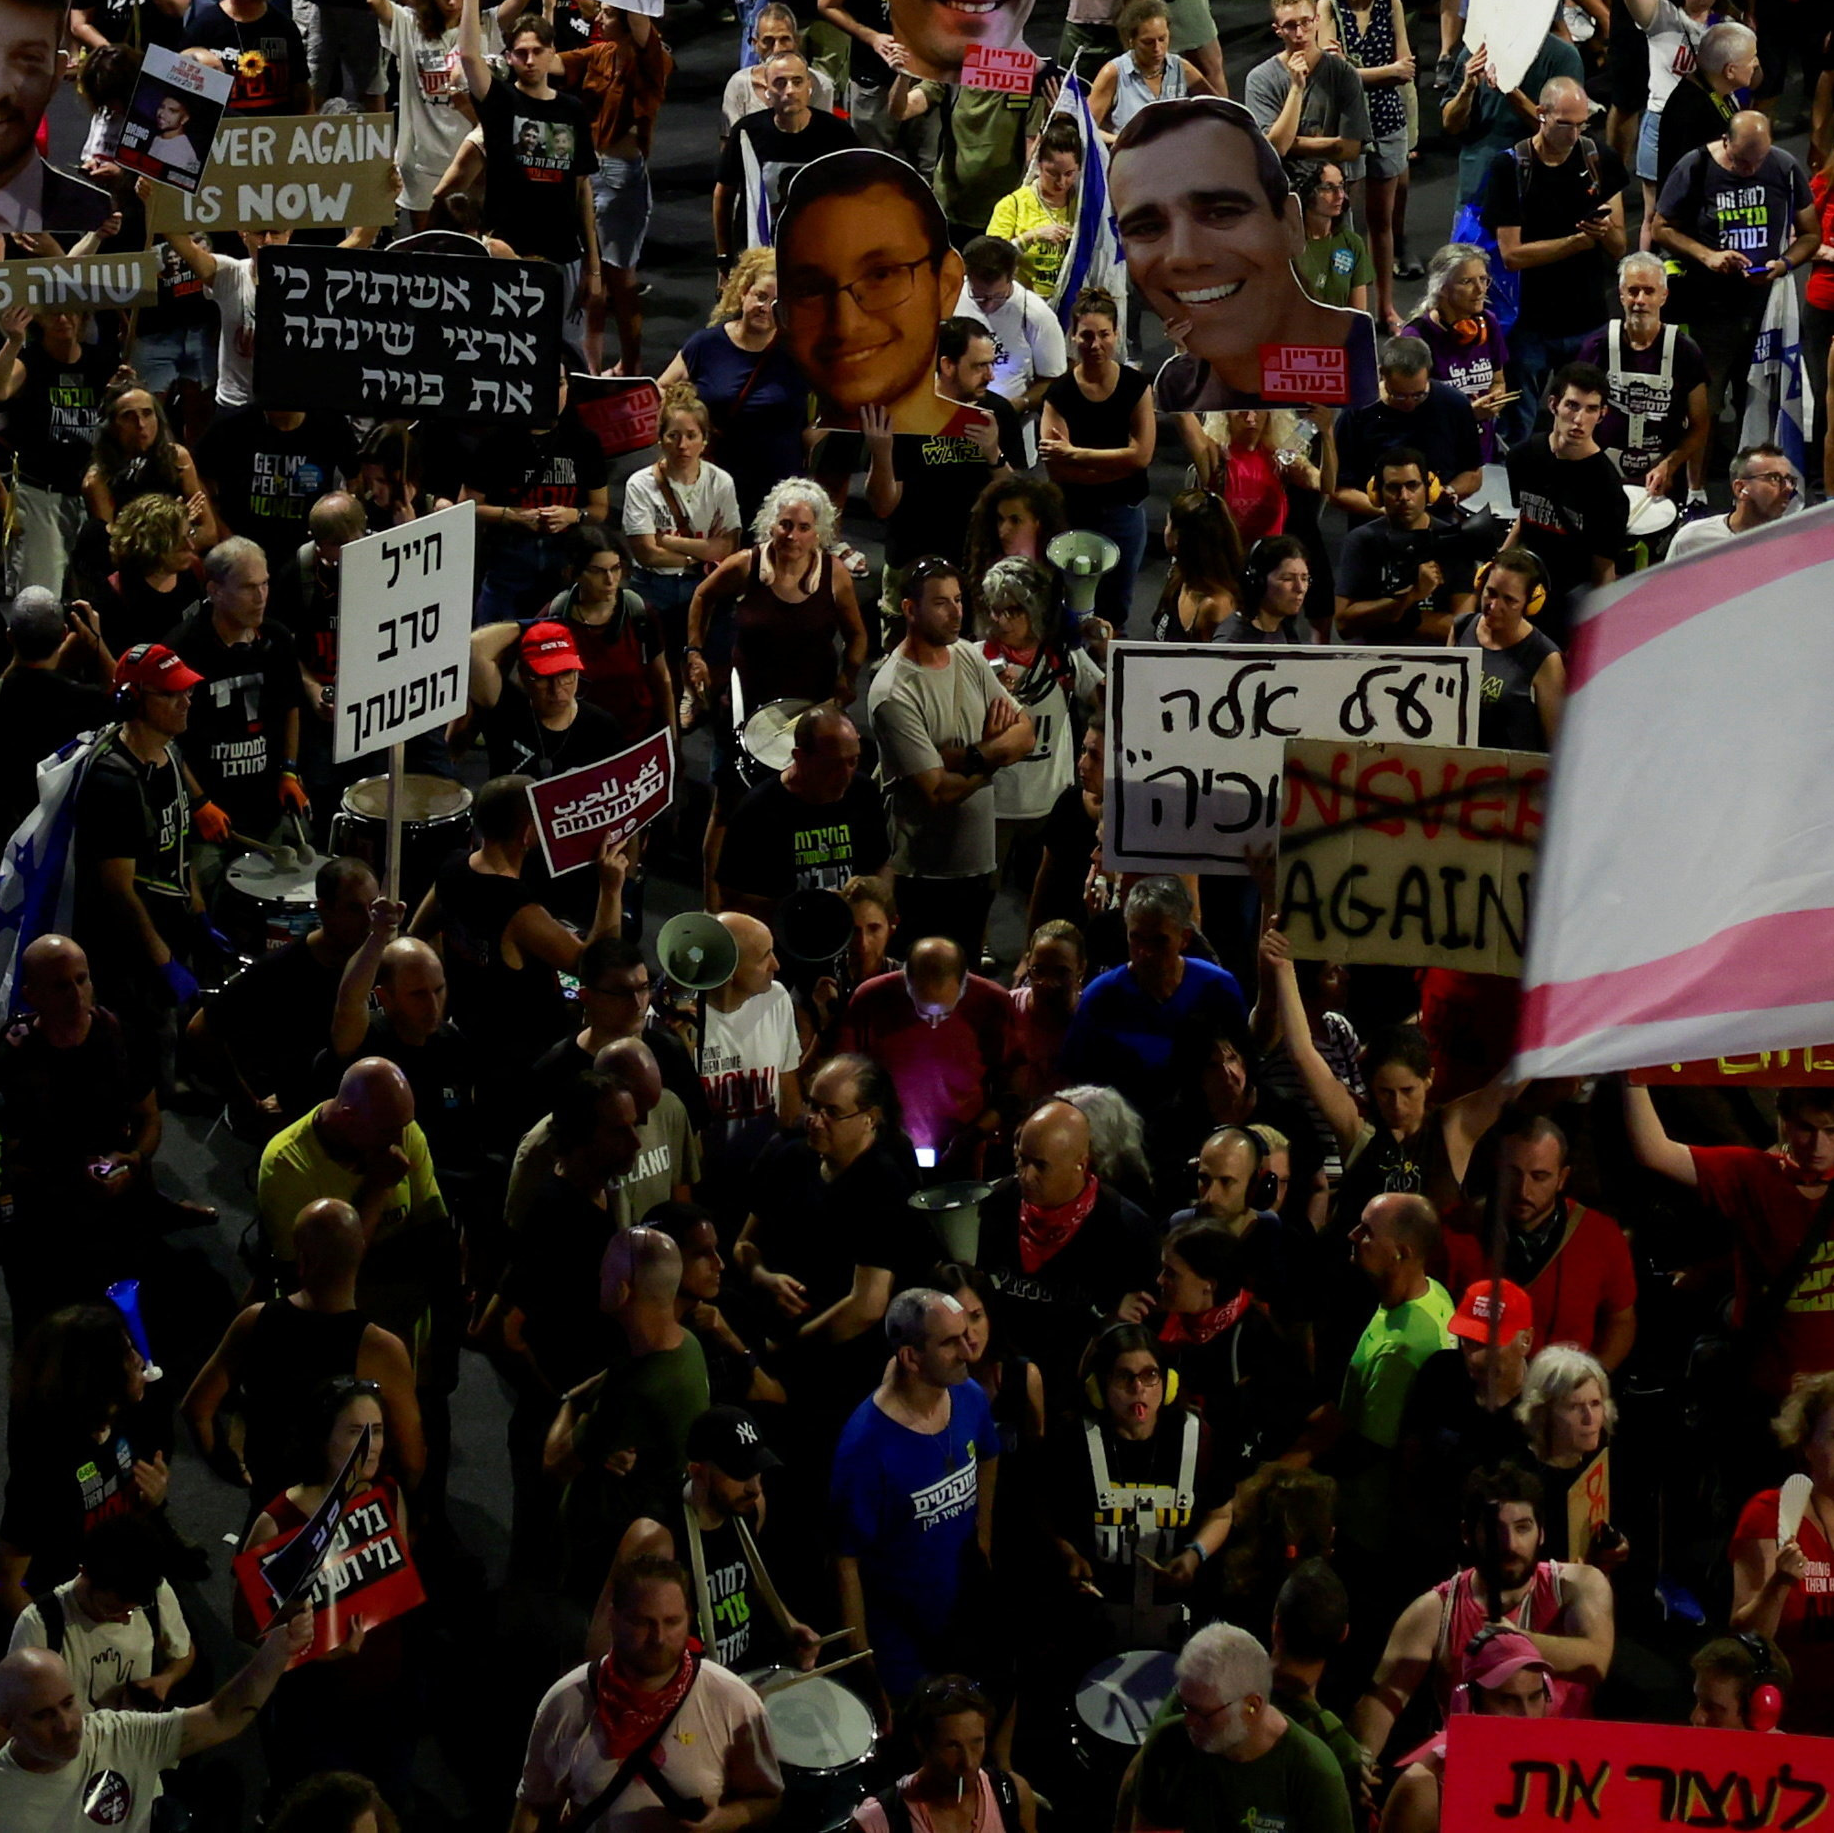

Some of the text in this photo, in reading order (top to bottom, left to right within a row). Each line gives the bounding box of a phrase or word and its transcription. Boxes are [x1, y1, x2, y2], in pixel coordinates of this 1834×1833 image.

[984, 49, 1035, 68] עדיין
[972, 72, 1031, 92] בעזה.
[212, 116, 392, 167] VER AGAIN
[183, 181, 353, 224] IS NOW
[1720, 207, 1769, 228] עדיין
[1720, 228, 1772, 249] בעזה?
[27, 262, 141, 305] שואה
[271, 263, 546, 318] לא אשיתוק כי
[283, 312, 538, 366] ארצי שינתה
[1285, 349, 1343, 370] עדיין
[361, 366, 534, 416] את פניה
[1276, 373, 1343, 392] בעזה.
[253, 452, 280, 476] GET
[382, 531, 443, 590] חייל
[377, 602, 441, 663] סרב
[346, 664, 459, 754] הופעתך
[1160, 661, 1302, 739] אלה
[210, 735, 268, 761] לממשלת
[553, 777, 620, 817] للحرب
[1276, 860, 1531, 958] AGAIN
[348, 1500, 389, 1537] בלי
[363, 1534, 403, 1572] בלי
[1493, 1758, 1831, 1833] לעצור את
